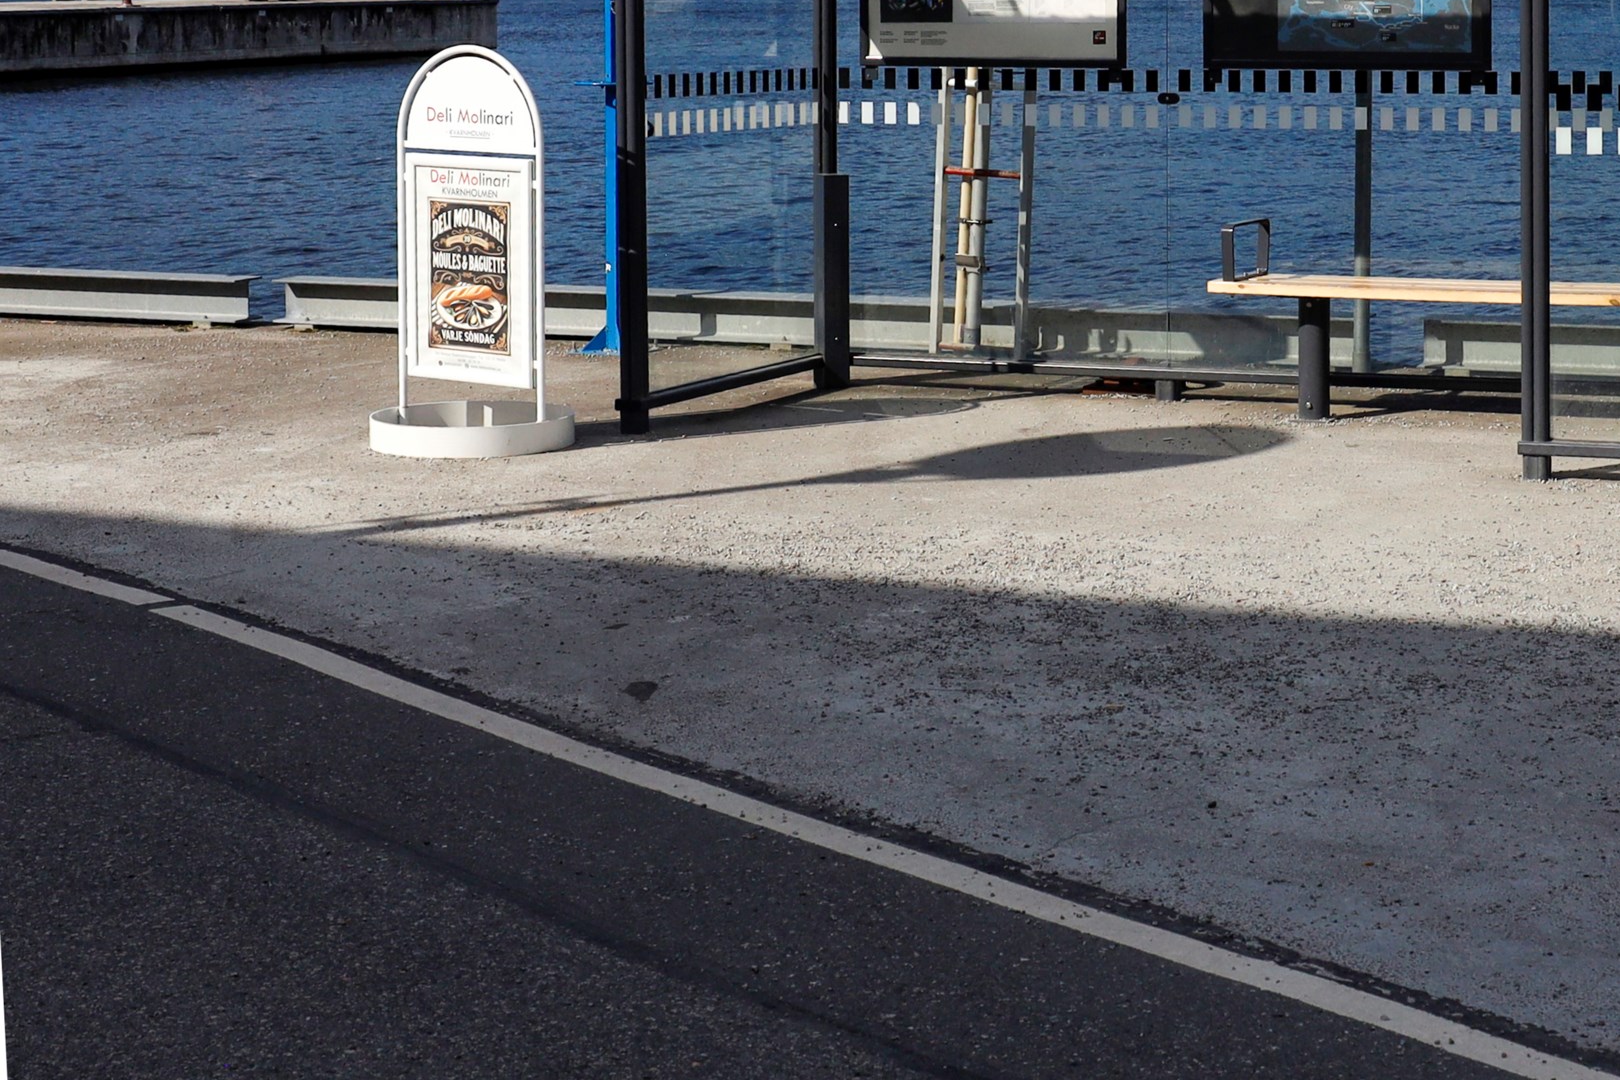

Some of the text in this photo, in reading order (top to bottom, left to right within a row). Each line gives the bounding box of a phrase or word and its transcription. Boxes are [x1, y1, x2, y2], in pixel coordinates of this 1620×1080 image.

[426, 106, 513, 126] Deli Molinari
[430, 169, 510, 188] Deli Molinari
[441, 187, 498, 198] KVARNHOLMEN
[432, 207, 505, 246] DELI MOLINARI
[462, 254, 468, 270] &
[468, 254, 506, 274] BAGUETTE
[441, 328, 463, 342] VARJE
